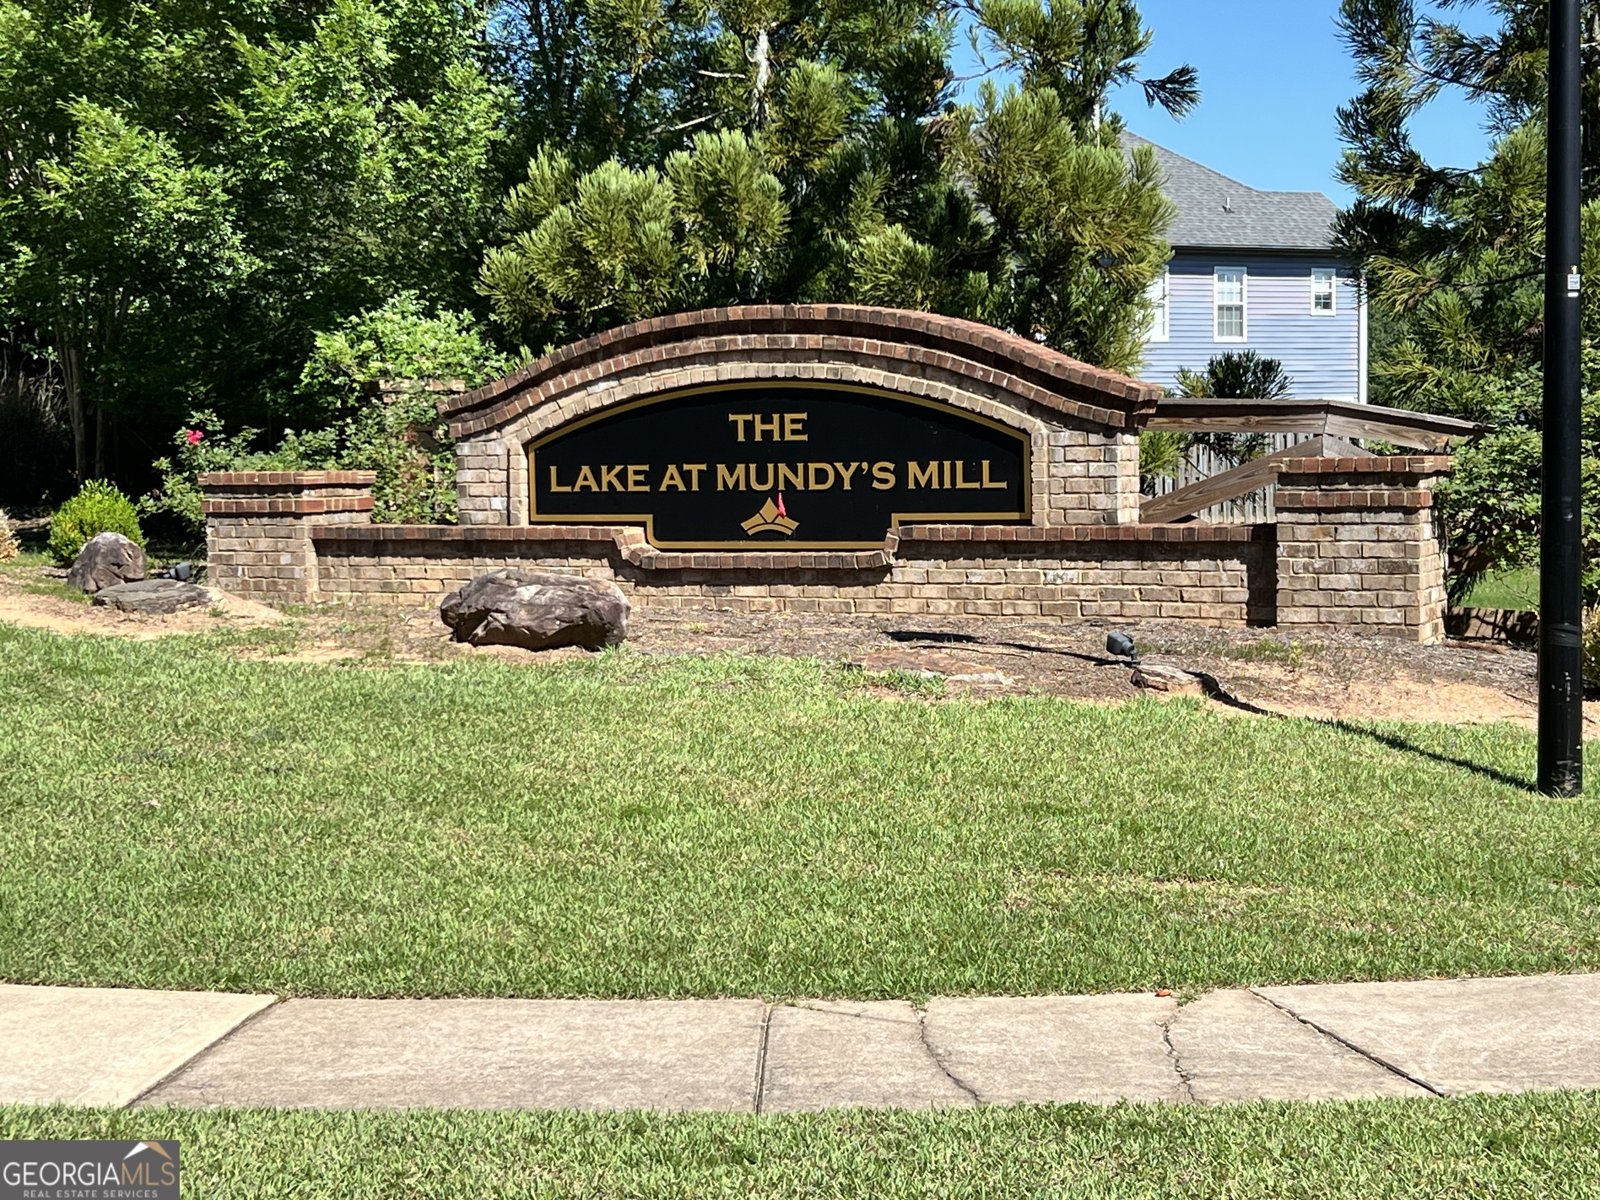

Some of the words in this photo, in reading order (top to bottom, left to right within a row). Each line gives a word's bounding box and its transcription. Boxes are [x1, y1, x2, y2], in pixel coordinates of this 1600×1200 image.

[728, 412, 809, 442] THE
[549, 464, 651, 493] LAKE
[658, 463, 706, 492] AT
[716, 461, 896, 491] MUNDY'S
[907, 460, 1008, 489] MILL
